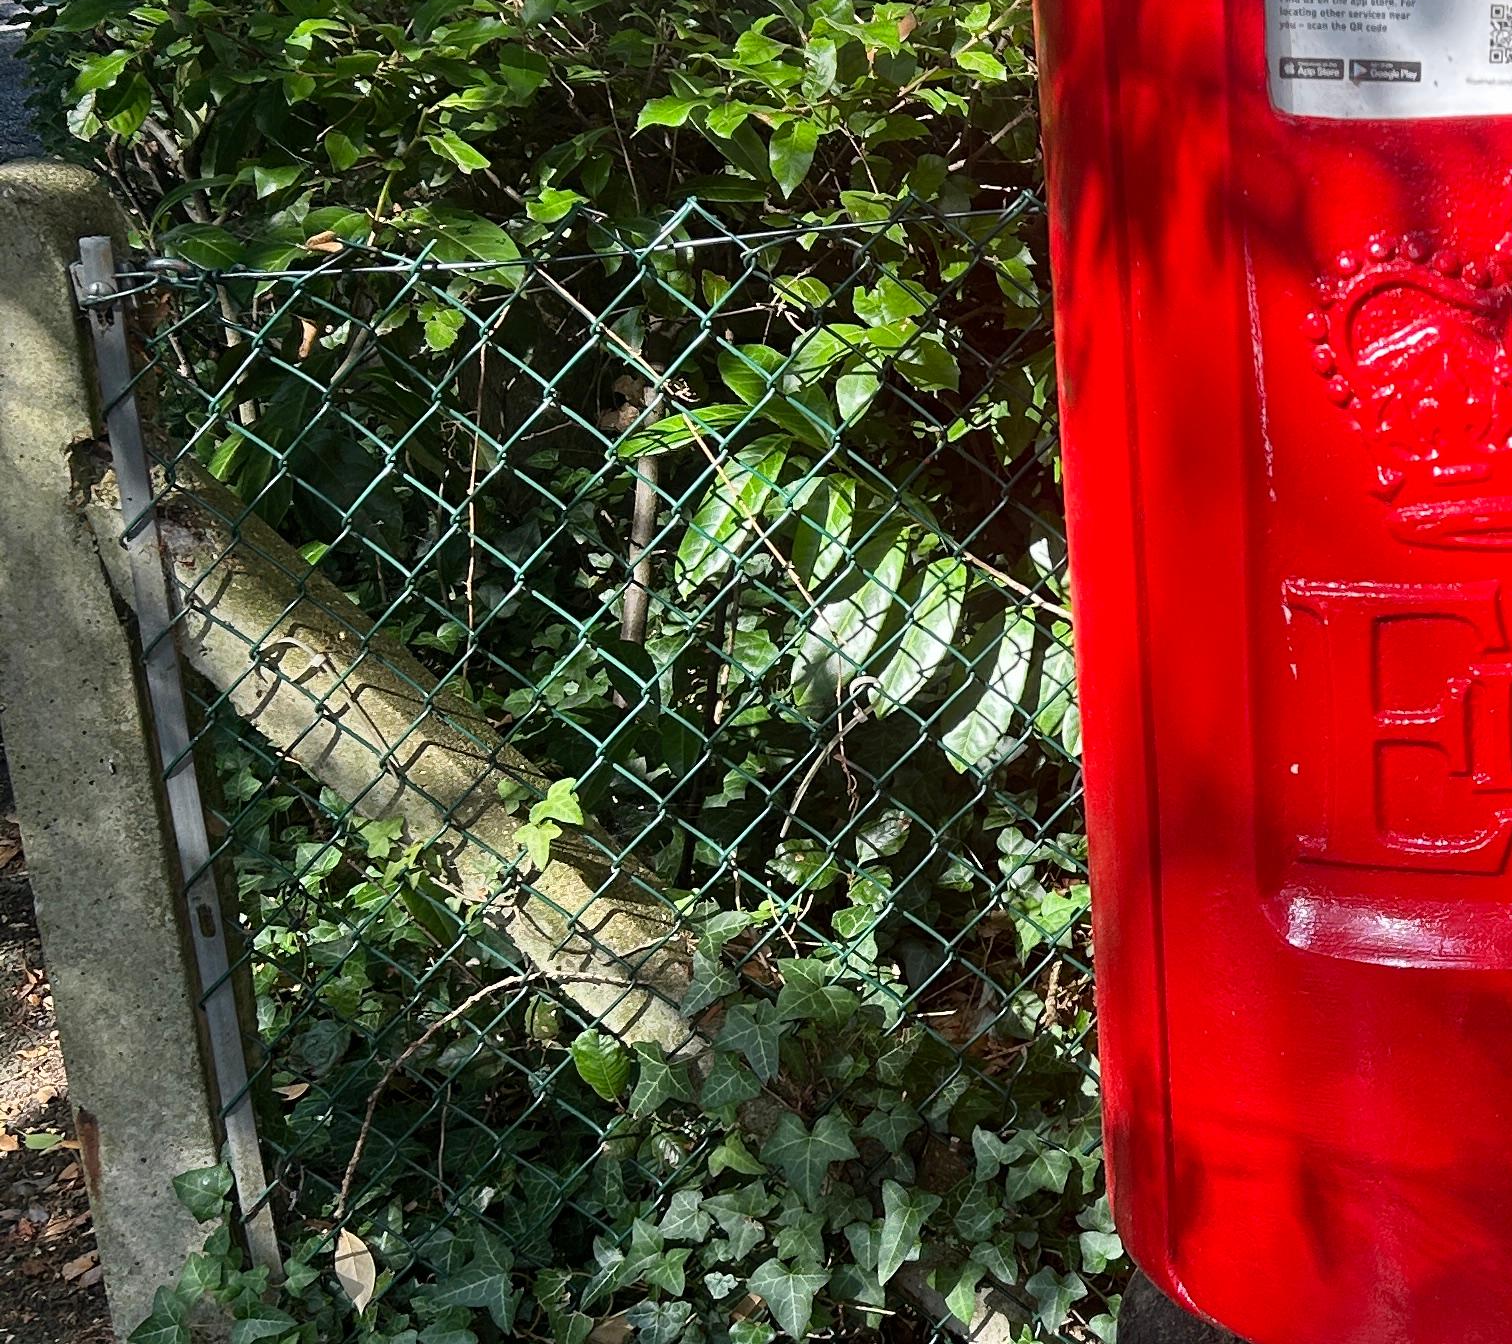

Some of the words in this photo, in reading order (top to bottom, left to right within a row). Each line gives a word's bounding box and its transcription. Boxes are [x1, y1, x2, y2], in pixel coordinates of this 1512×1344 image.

[1280, 7, 1317, 19] locating
[1320, 8, 1346, 18] other
[1349, 9, 1386, 20] services
[1389, 12, 1411, 20] near
[1279, 22, 1297, 31] you
[1307, 22, 1328, 31] scan
[1331, 21, 1346, 31] the
[1350, 21, 1363, 32] QR
[1366, 23, 1387, 32] code
